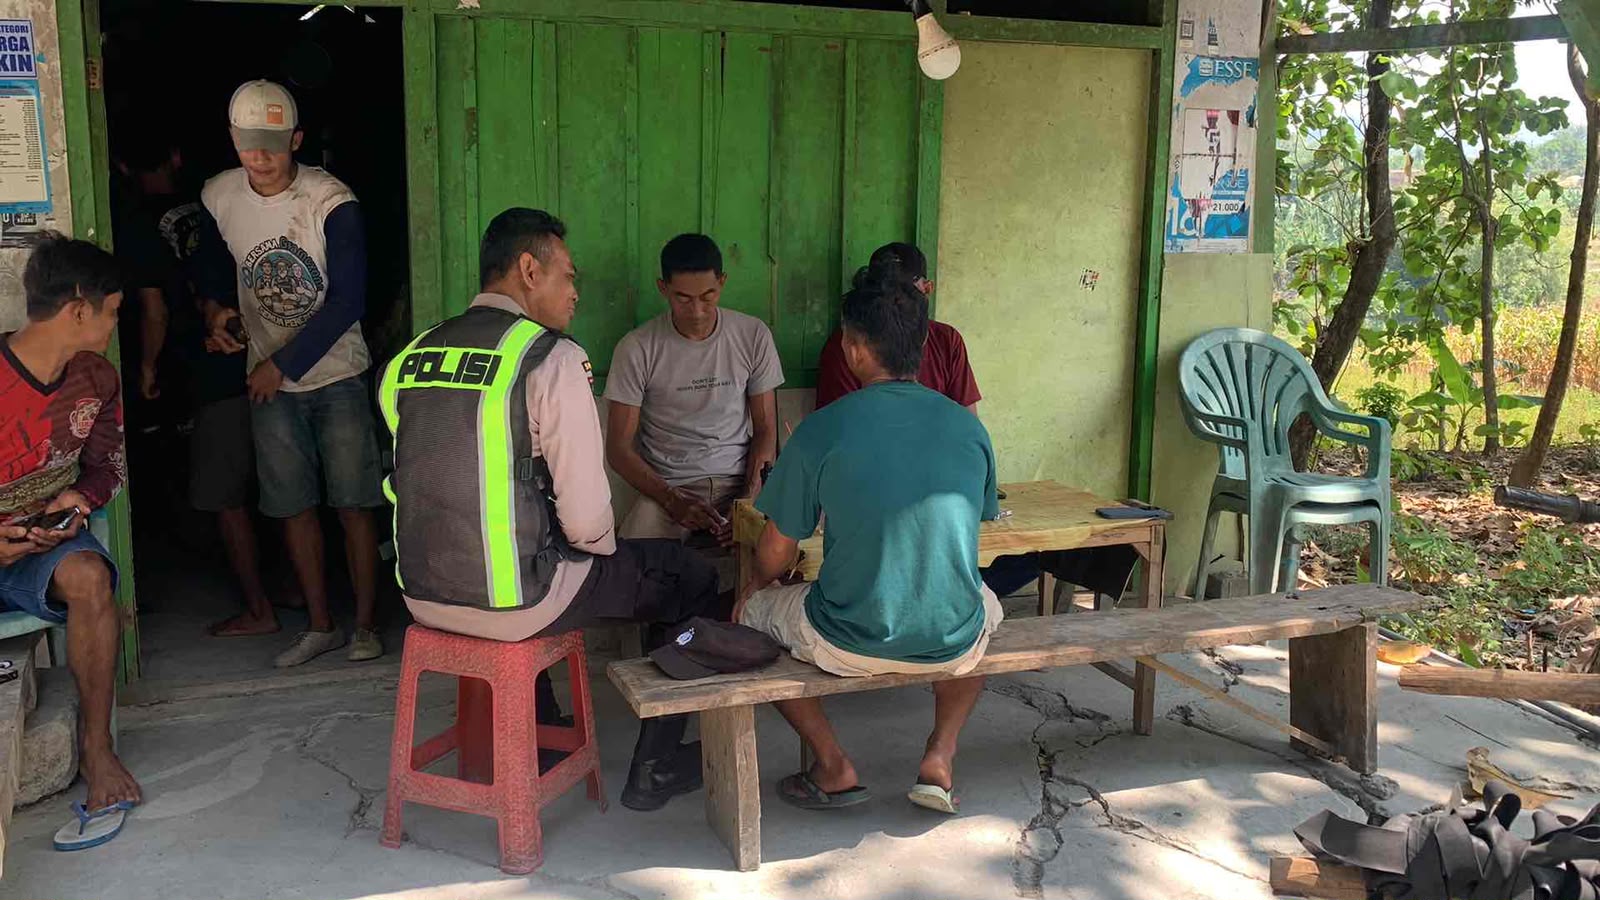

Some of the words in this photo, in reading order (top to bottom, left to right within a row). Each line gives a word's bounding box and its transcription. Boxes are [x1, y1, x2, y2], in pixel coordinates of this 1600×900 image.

[0, 24, 29, 33] TEGORI
[1213, 203, 1239, 211] 21.000
[244, 238, 280, 268] BERSAMA
[397, 350, 503, 386] POLISI
